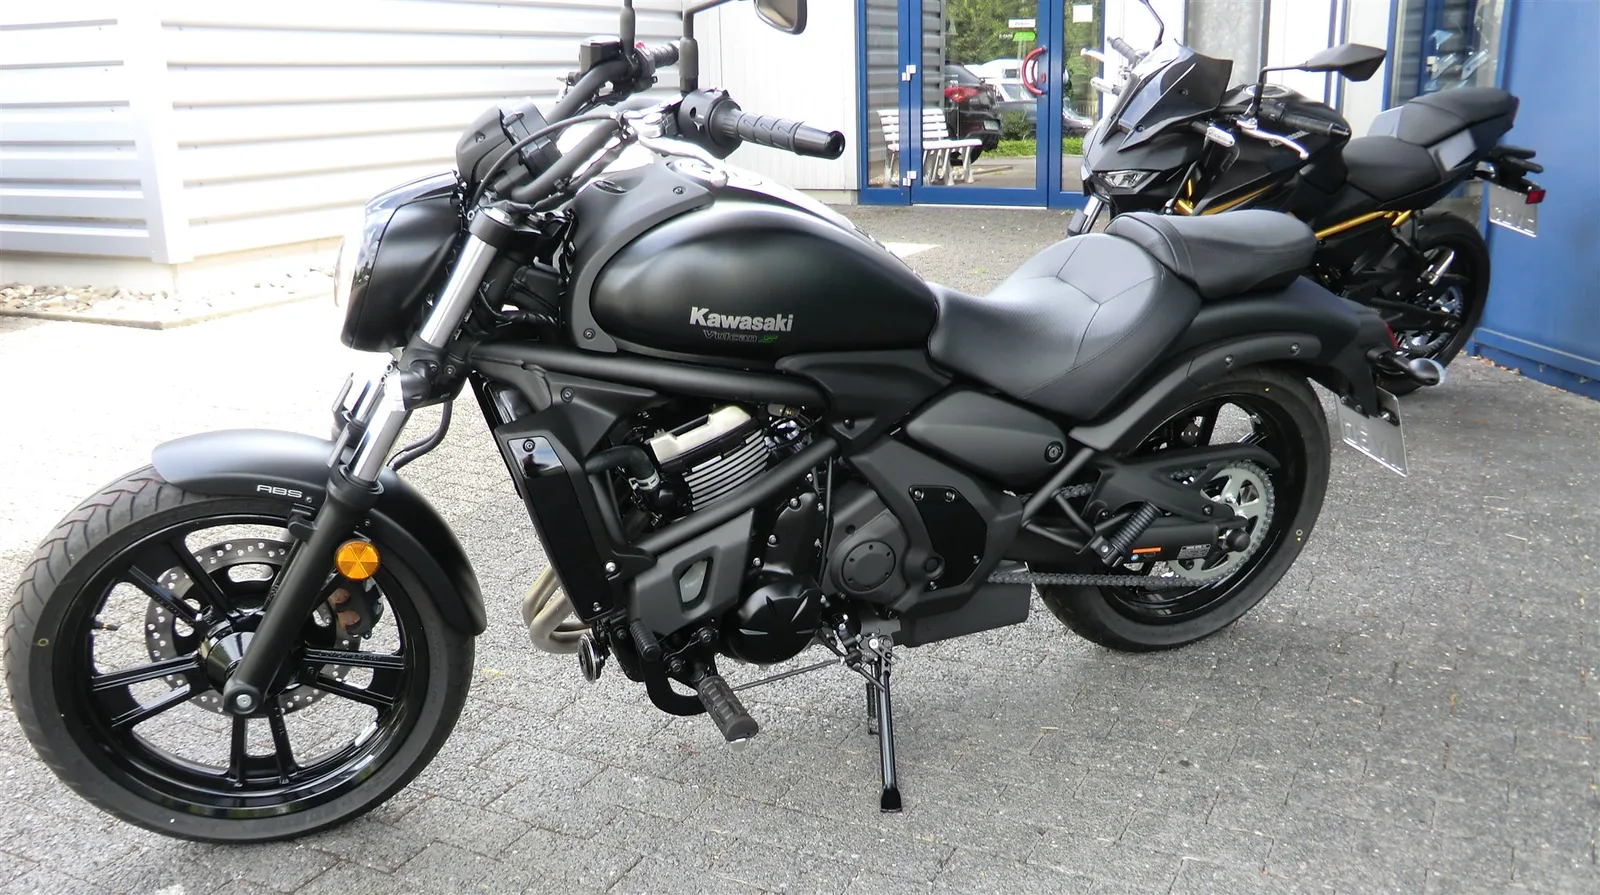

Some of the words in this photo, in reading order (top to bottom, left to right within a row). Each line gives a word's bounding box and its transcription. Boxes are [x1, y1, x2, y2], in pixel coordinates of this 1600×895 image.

[690, 306, 794, 332] Kawasaki
[702, 329, 758, 343] Vulcan
[256, 484, 303, 499] ABS
